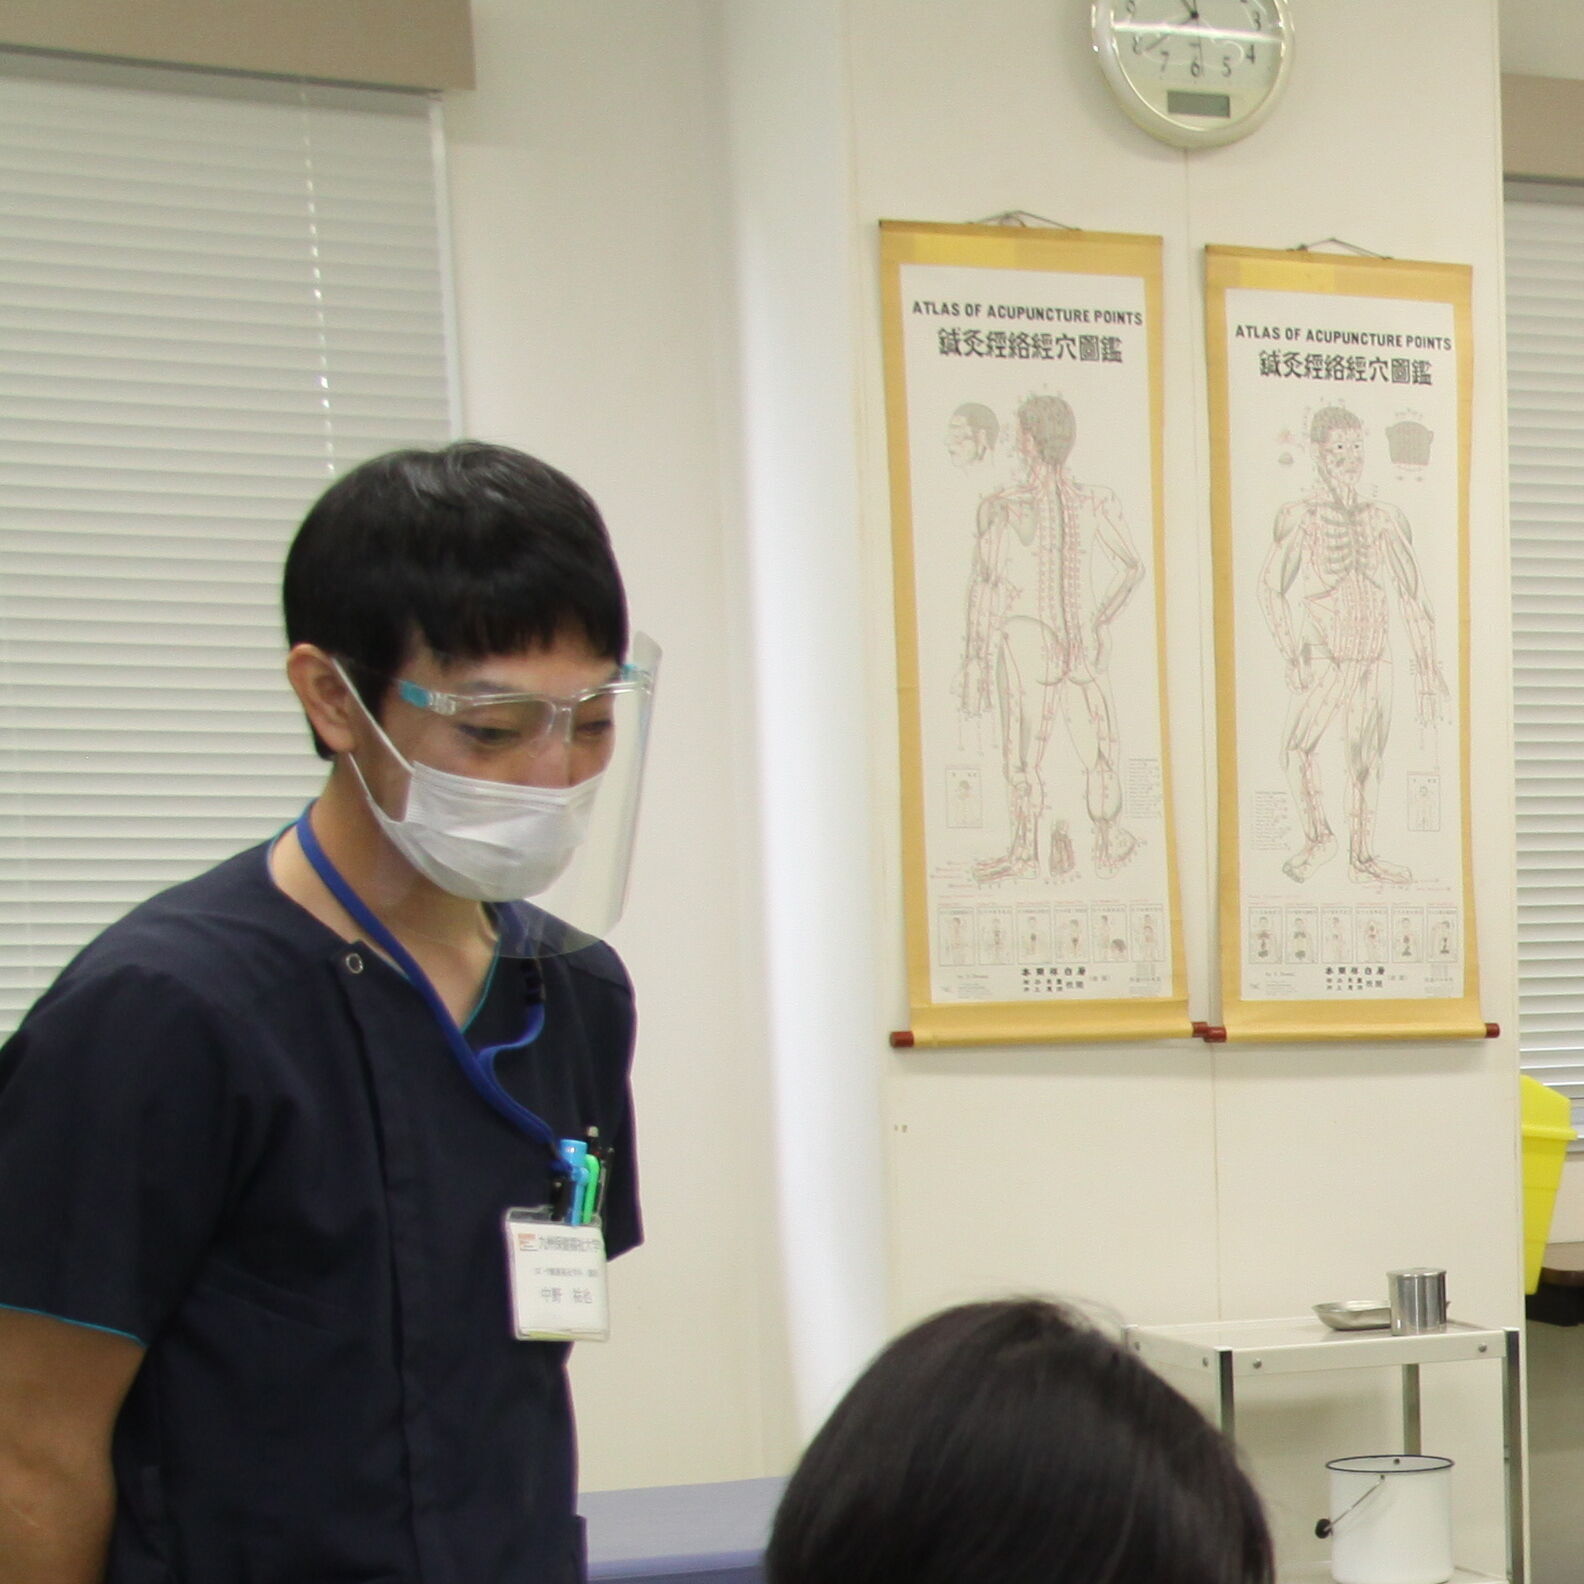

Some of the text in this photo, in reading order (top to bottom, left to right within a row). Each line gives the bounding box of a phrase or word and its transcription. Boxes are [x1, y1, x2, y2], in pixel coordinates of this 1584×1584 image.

[1252, 11, 1261, 31] 3
[1160, 51, 1170, 73] 7
[1246, 44, 1255, 64] 4
[1189, 57, 1200, 77] 6
[1222, 56, 1232, 77] 5
[912, 301, 1143, 325] ATLAS OF ACUPUNCTURE POINTS
[1235, 325, 1452, 350] ATLAS OF ACUPUNCTURE POINTS
